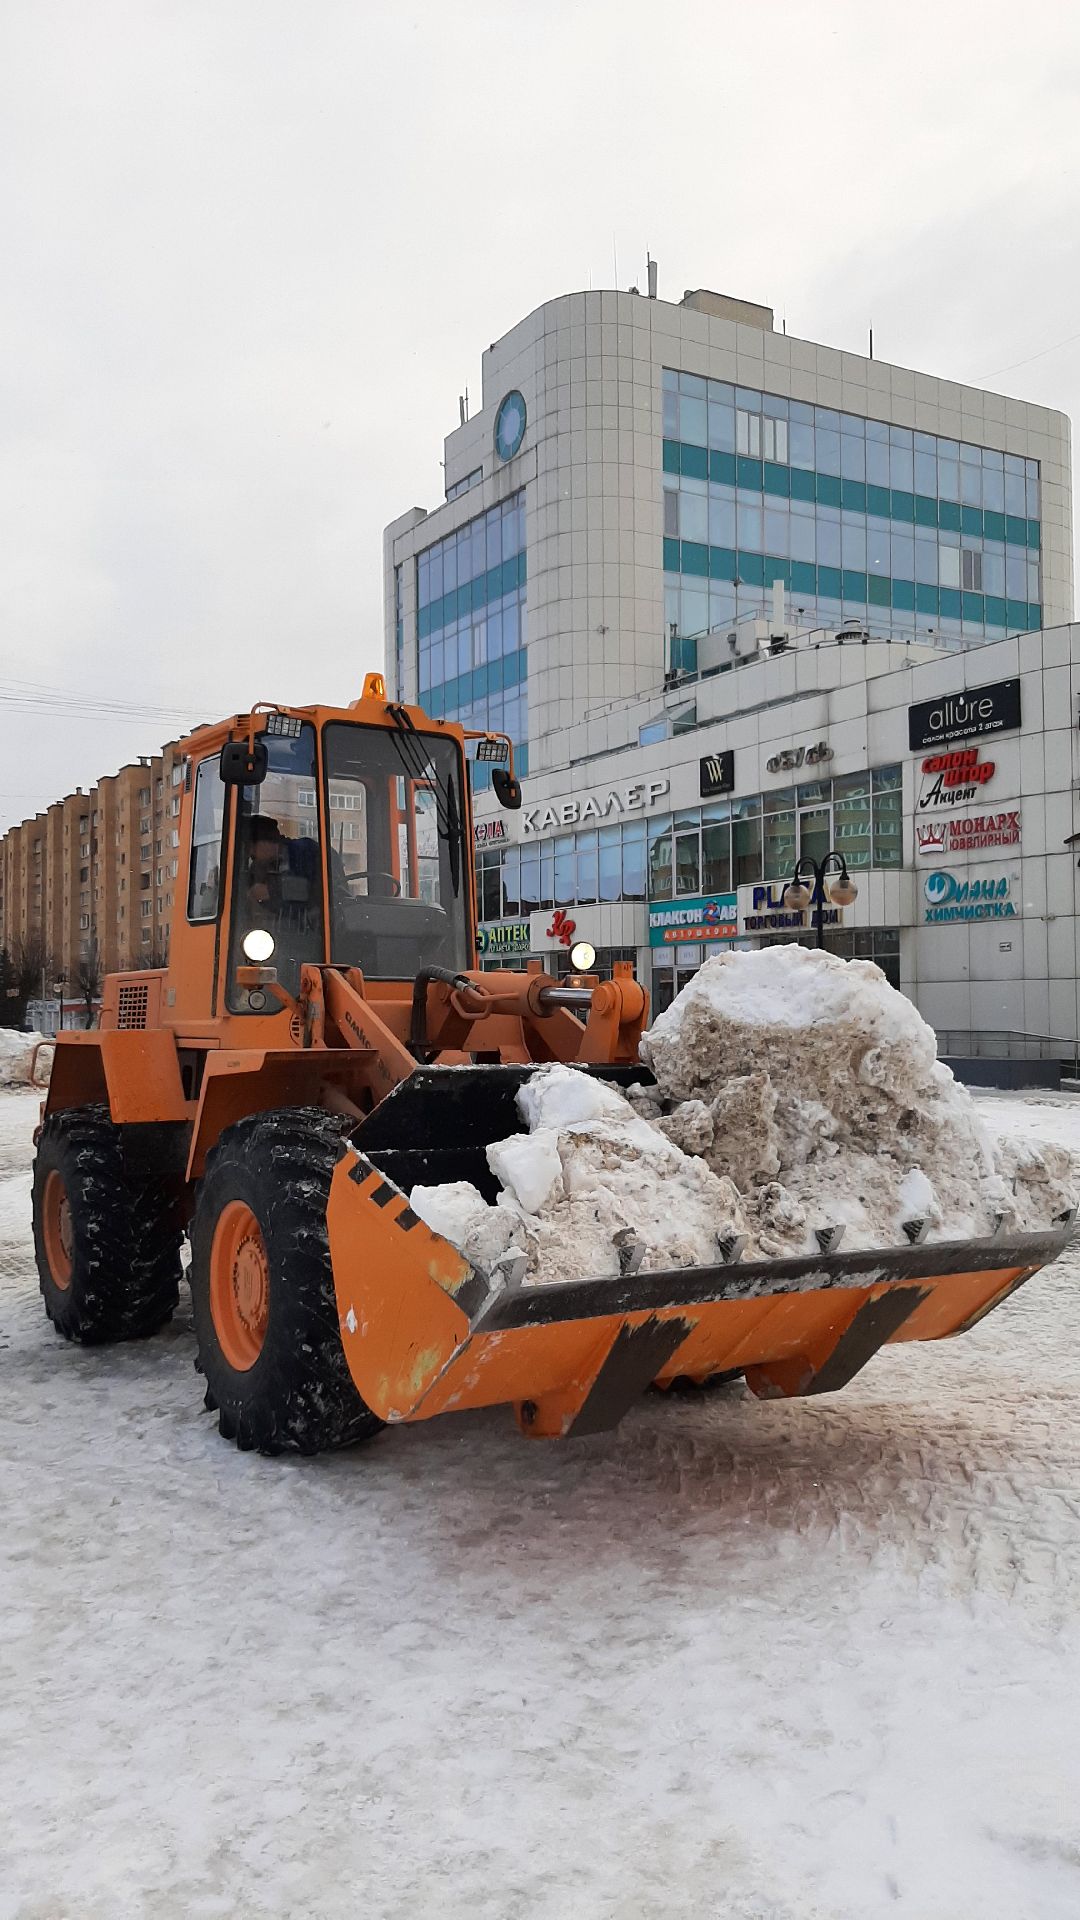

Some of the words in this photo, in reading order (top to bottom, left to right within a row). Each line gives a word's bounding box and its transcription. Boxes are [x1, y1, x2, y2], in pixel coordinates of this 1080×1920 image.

[929, 697, 993, 730] allure
[522, 779, 671, 833] КАВАЛЕР
[950, 811, 1021, 837] МОНАРХ
[649, 908, 704, 928] КЛАКСОН
[925, 901, 1018, 922] ХИМЧИСТКА
